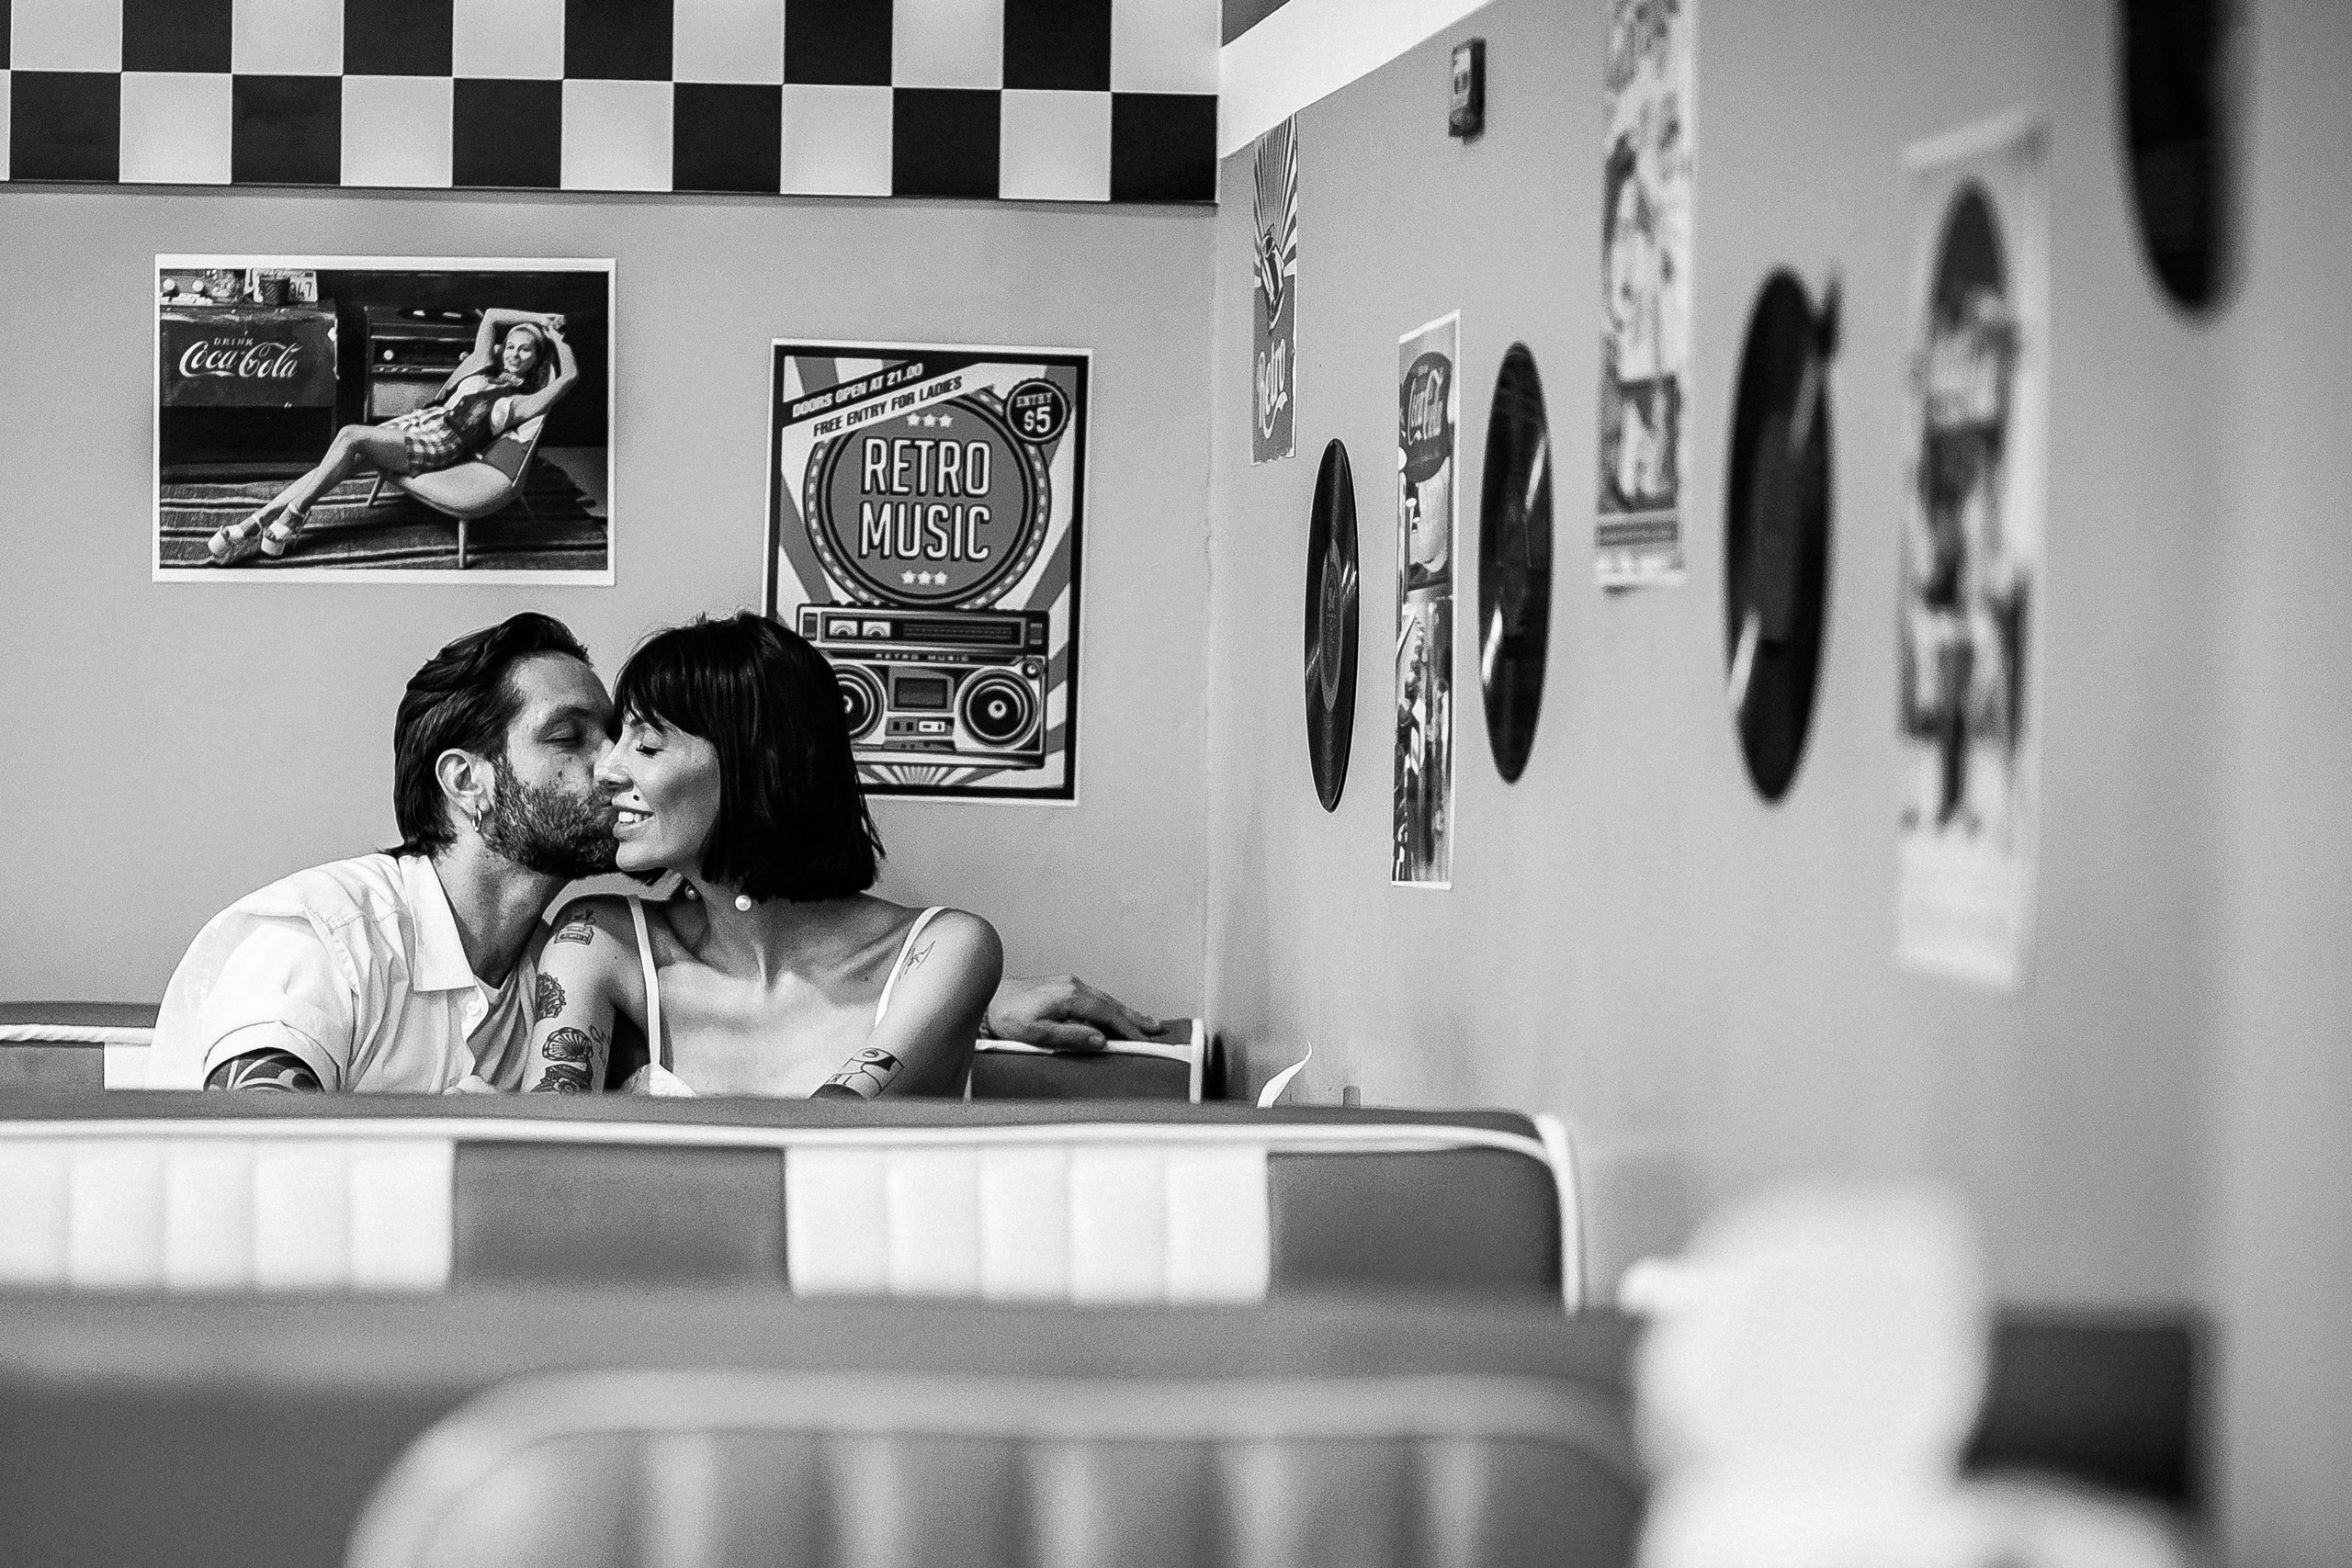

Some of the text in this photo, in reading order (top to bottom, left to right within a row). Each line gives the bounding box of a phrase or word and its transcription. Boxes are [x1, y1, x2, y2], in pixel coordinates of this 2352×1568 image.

[179, 340, 304, 378] Coca-Cola
[213, 336, 254, 346] DRINK
[792, 393, 833, 417] DOORS
[835, 381, 867, 402] OPEN
[869, 375, 885, 392] AT
[813, 376, 963, 437] FREE ENTRY FOR LADIES
[1016, 392, 1052, 408] ENTRY
[1024, 406, 1050, 433] $5
[861, 436, 991, 496] RETRO
[859, 502, 990, 559] MUSIC
